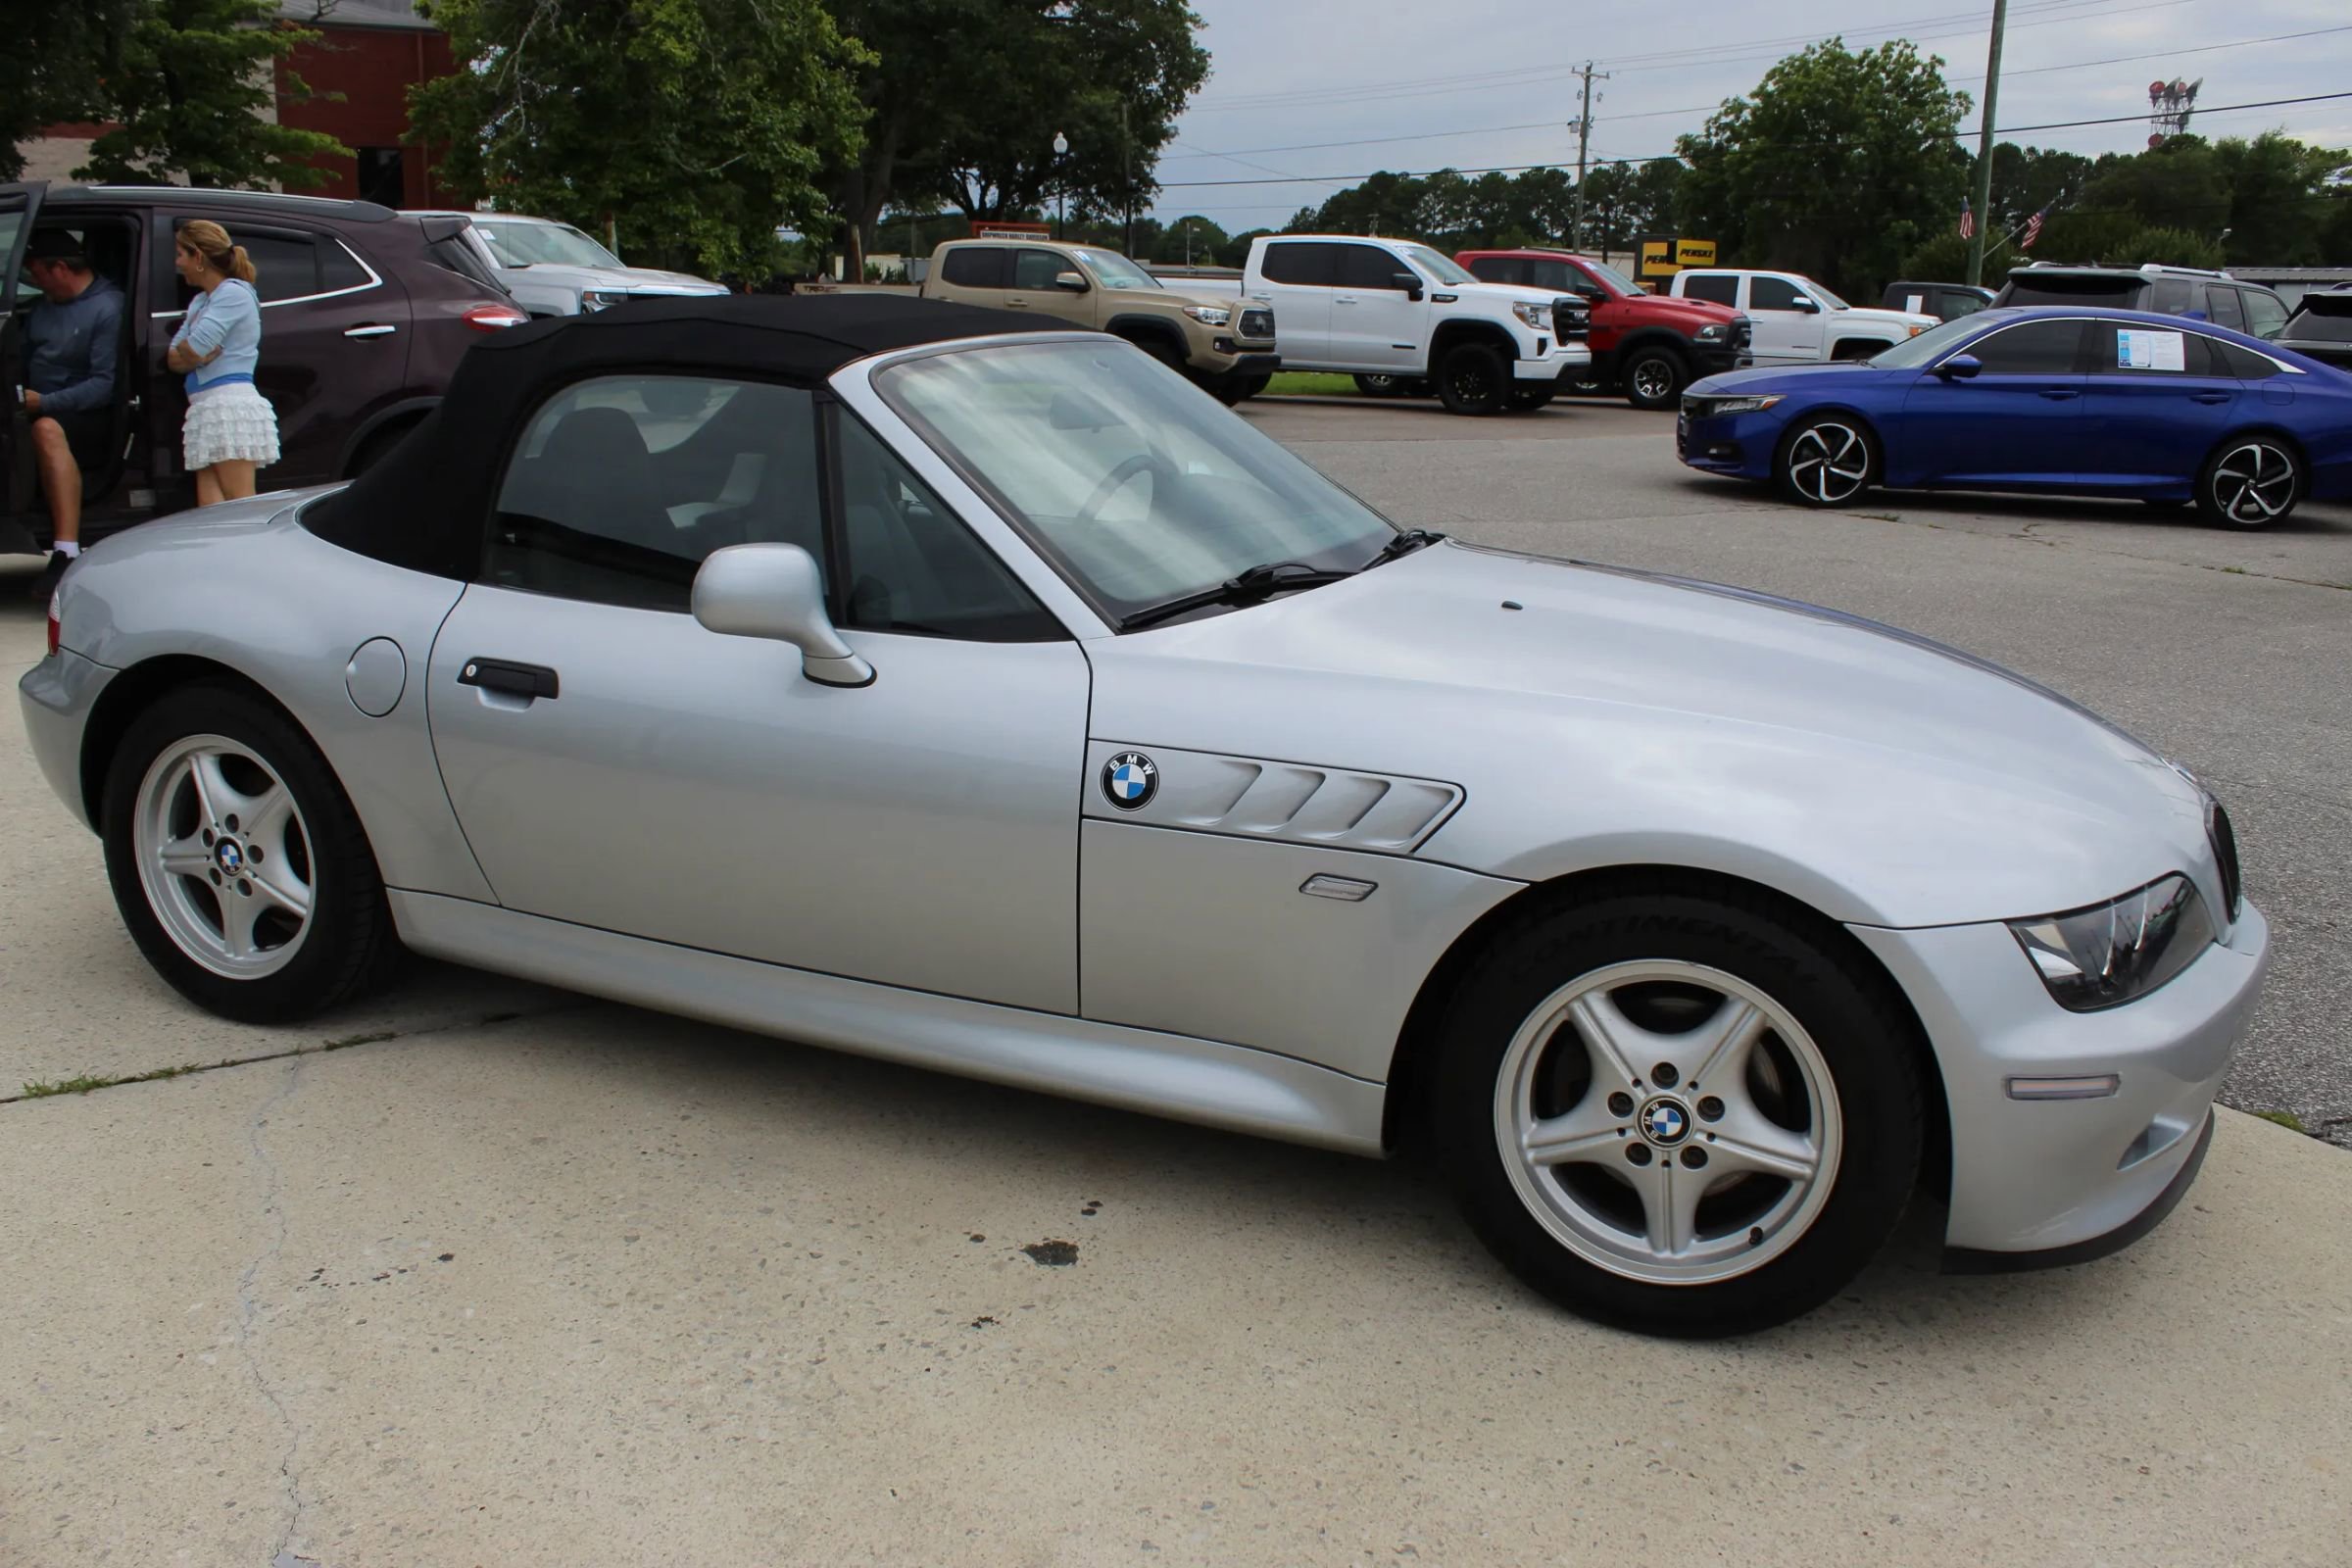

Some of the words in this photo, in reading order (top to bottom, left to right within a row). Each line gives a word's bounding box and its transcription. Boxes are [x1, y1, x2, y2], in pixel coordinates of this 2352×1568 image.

[1680, 248, 1713, 259] PENSKE
[1108, 754, 1154, 775] BMW
[1643, 1102, 1660, 1140] BMW
